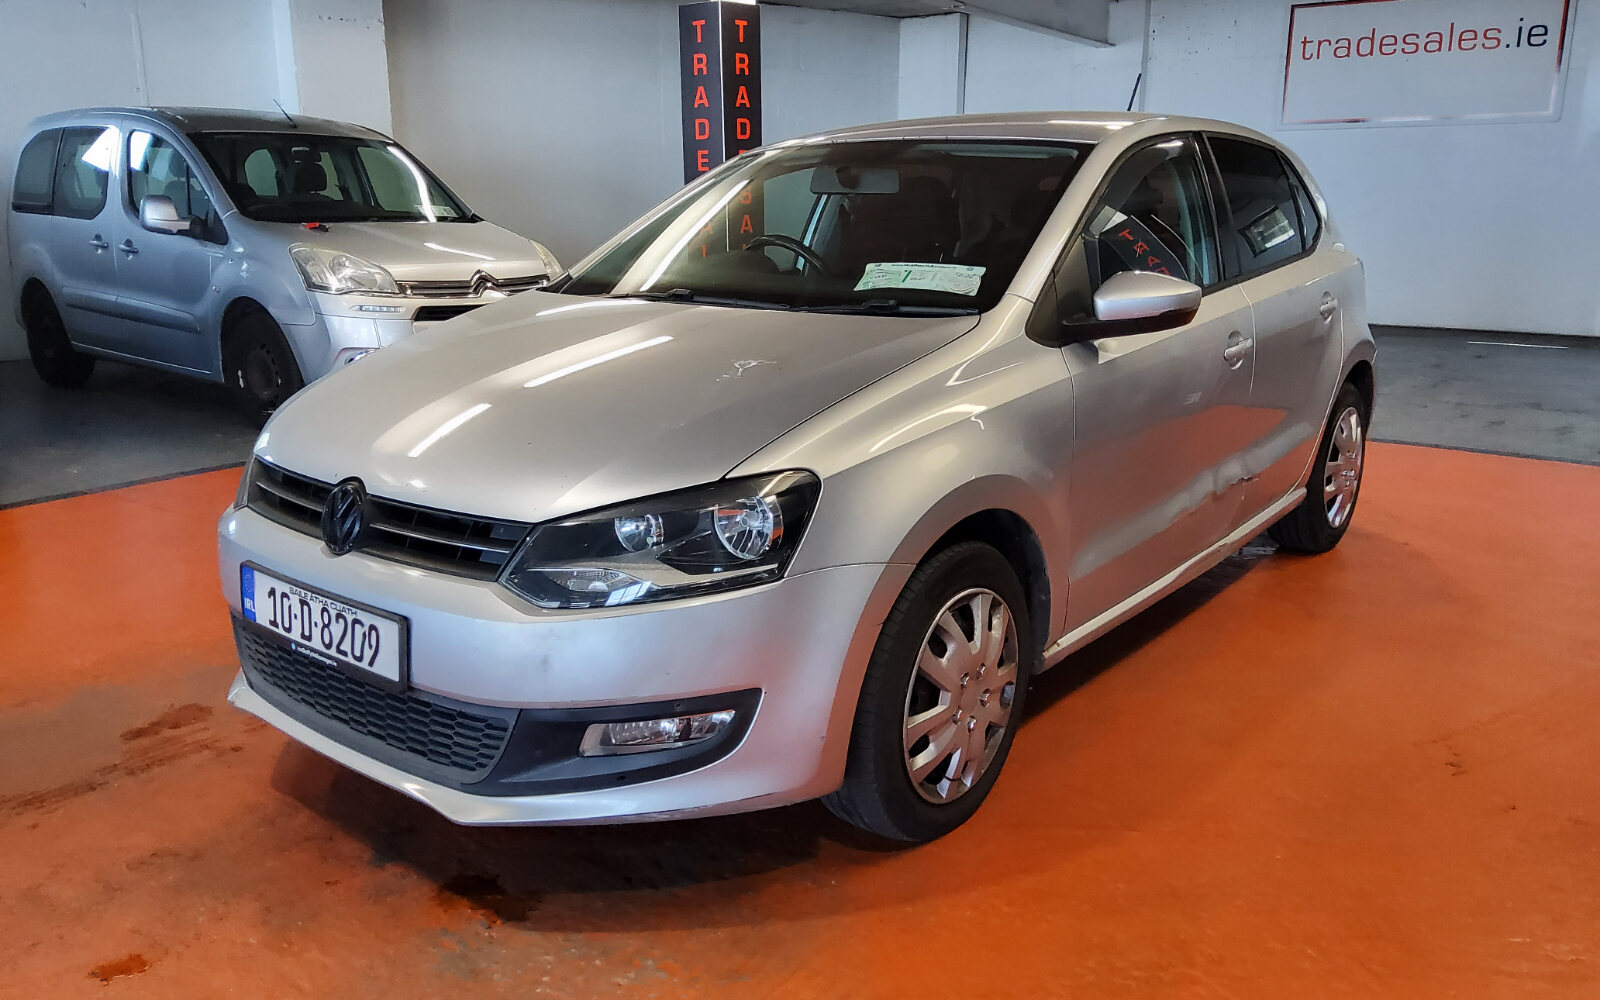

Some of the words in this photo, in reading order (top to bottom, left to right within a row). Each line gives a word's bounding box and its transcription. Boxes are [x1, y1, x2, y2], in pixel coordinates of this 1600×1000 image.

[1300, 17, 1549, 61] tradesales.ie
[691, 19, 710, 172] TRADE
[734, 19, 751, 156] TRAD
[244, 597, 256, 613] IRL
